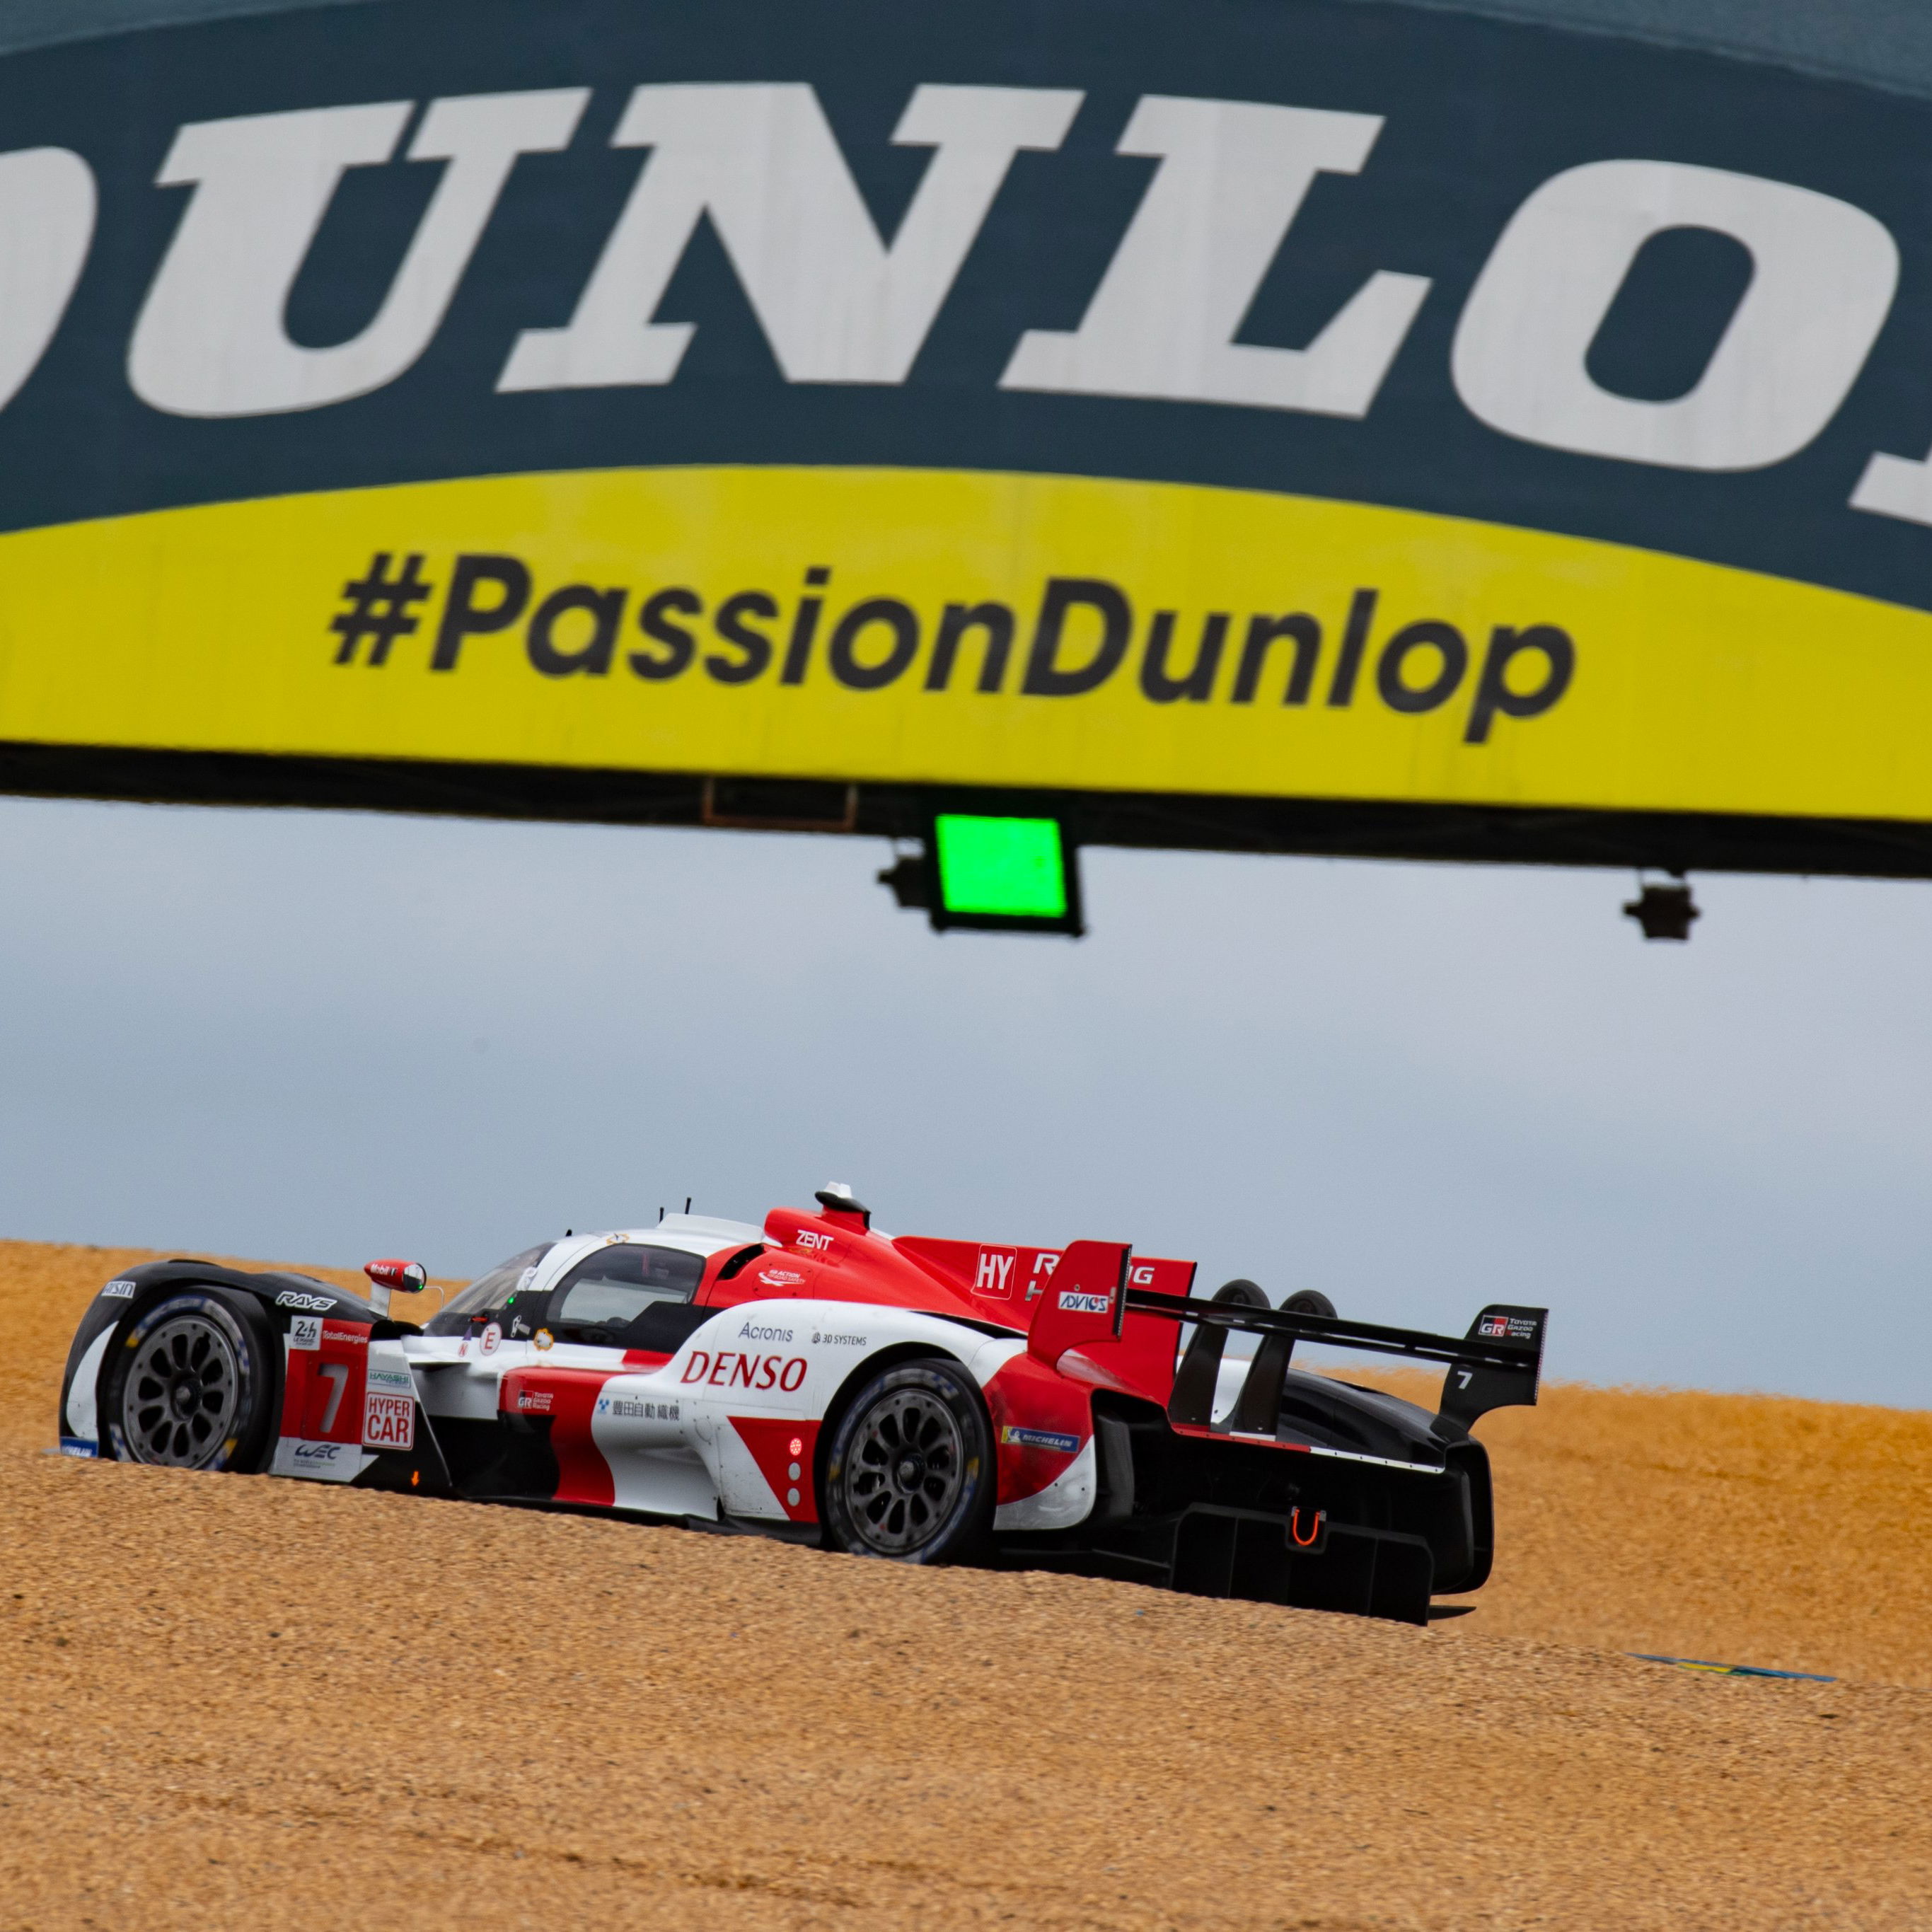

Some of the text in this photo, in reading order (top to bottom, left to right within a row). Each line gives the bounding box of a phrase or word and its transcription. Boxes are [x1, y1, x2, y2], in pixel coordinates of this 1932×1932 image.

[0, 83, 1932, 525] UNLO
[328, 552, 1577, 746] #PassionDunlop
[796, 1230, 834, 1251] ZENT
[977, 1254, 1014, 1290] HY
[276, 1291, 337, 1311] RAYS
[1060, 1295, 1106, 1311] ADVICS
[323, 1330, 368, 1344] TotalEnergies
[739, 1322, 794, 1342] Acronis
[1481, 1323, 1504, 1335] GR
[485, 1332, 496, 1349] E
[822, 1334, 867, 1346] 3D SYSTEMS
[369, 1372, 409, 1384] HAYASHI
[680, 1351, 808, 1392] DENSO
[1457, 1371, 1473, 1389] 7
[317, 1363, 349, 1434] 7
[369, 1397, 410, 1417] HYPER
[518, 1397, 532, 1408] GR
[368, 1414, 410, 1443] CAR
[1023, 1435, 1072, 1447] MICHELIN
[294, 1444, 342, 1459] WEC
